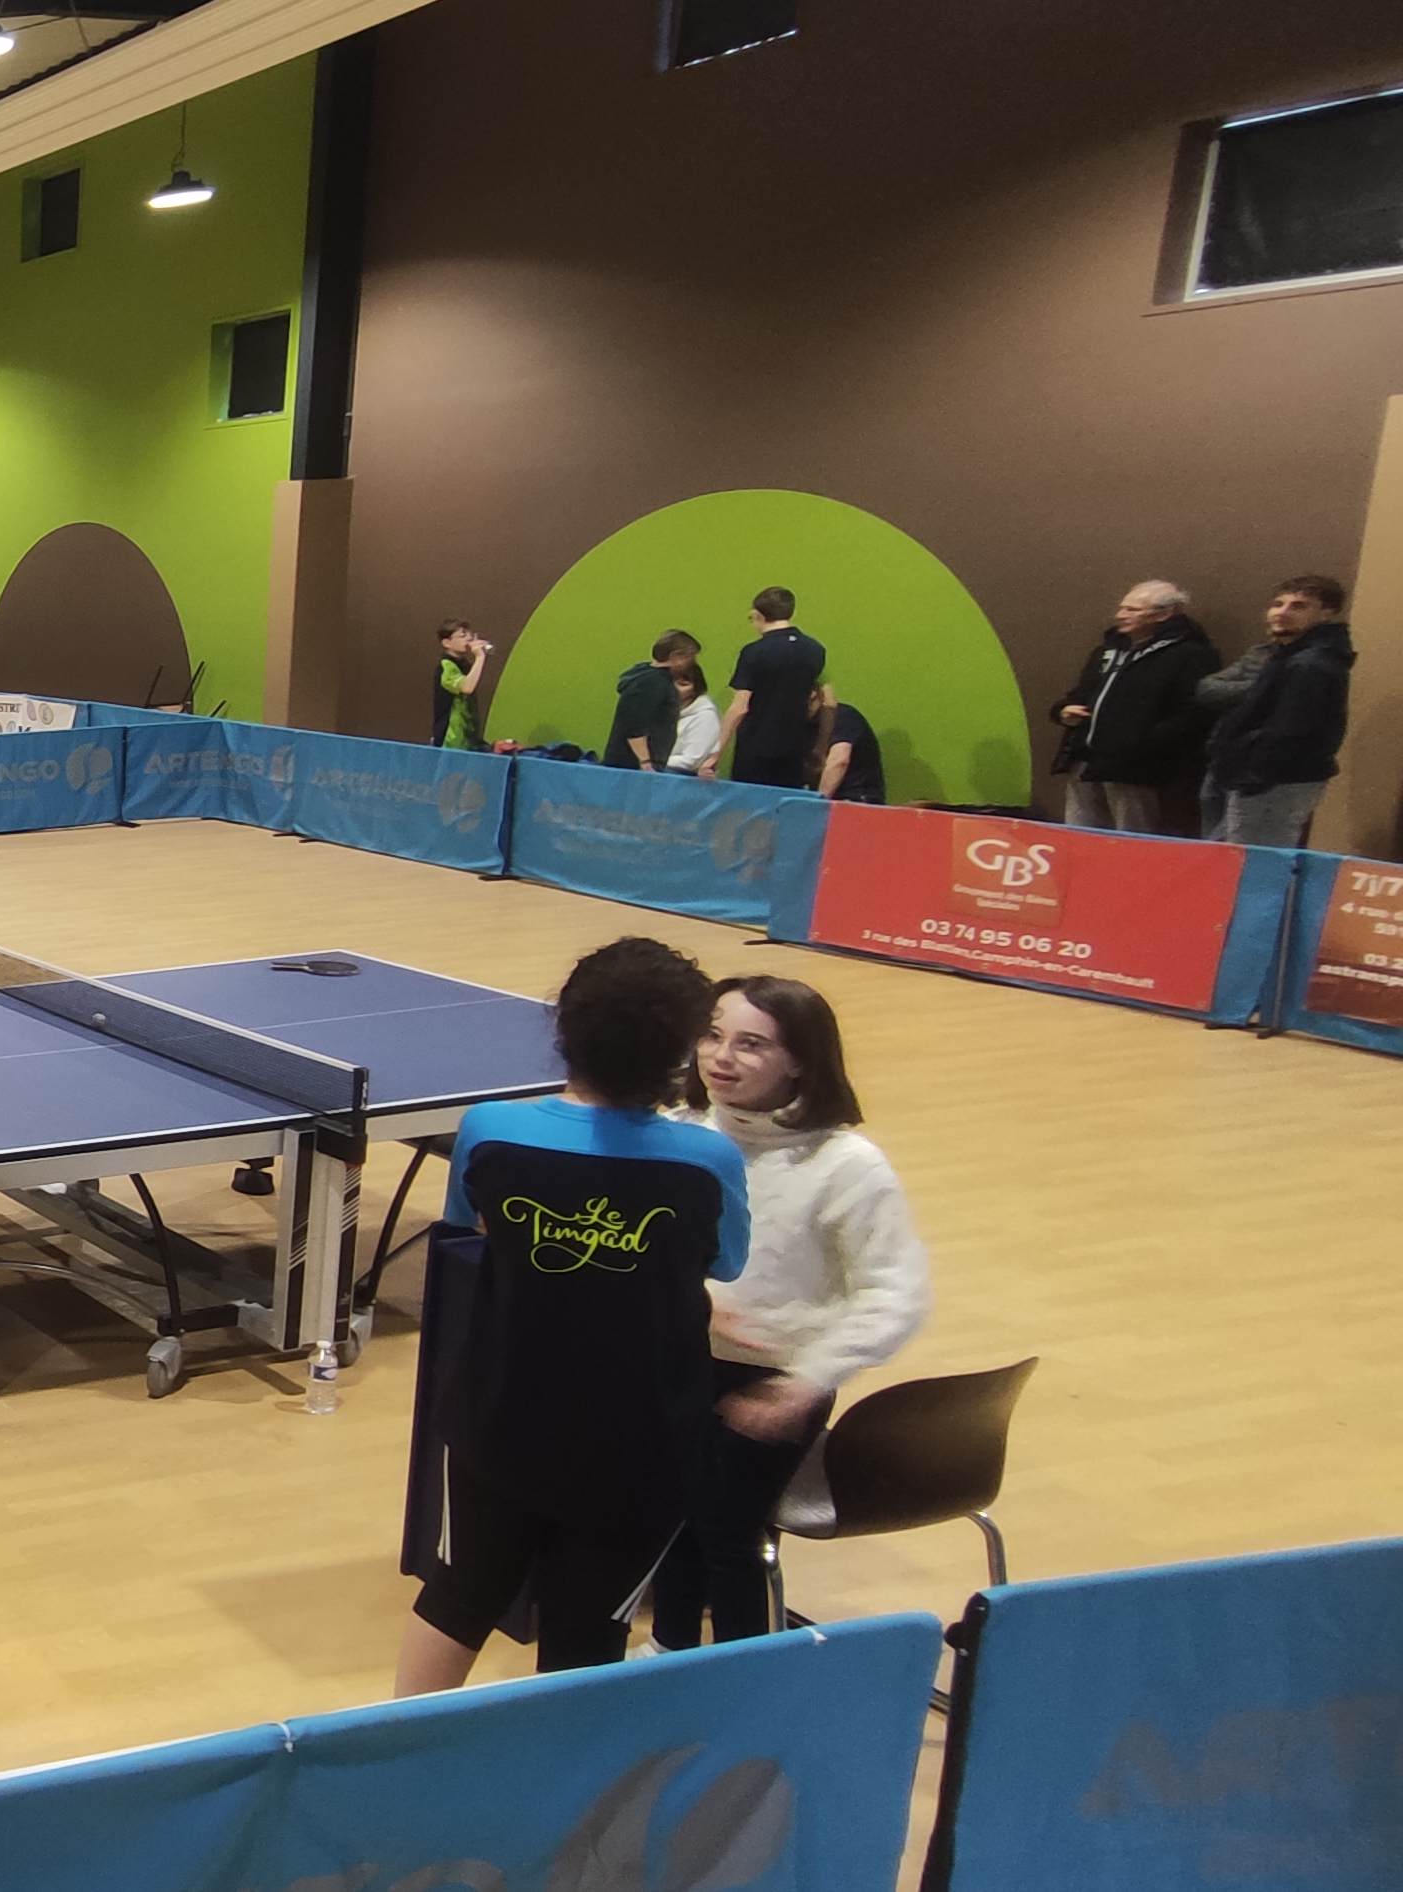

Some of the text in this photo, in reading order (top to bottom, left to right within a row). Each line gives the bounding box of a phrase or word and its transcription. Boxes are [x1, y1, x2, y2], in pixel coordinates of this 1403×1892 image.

[966, 838, 1056, 887] GBS
[921, 918, 1092, 959] 03 74 95 06 20
[502, 1196, 677, 1273] Timgad
[577, 1196, 628, 1231] Le
